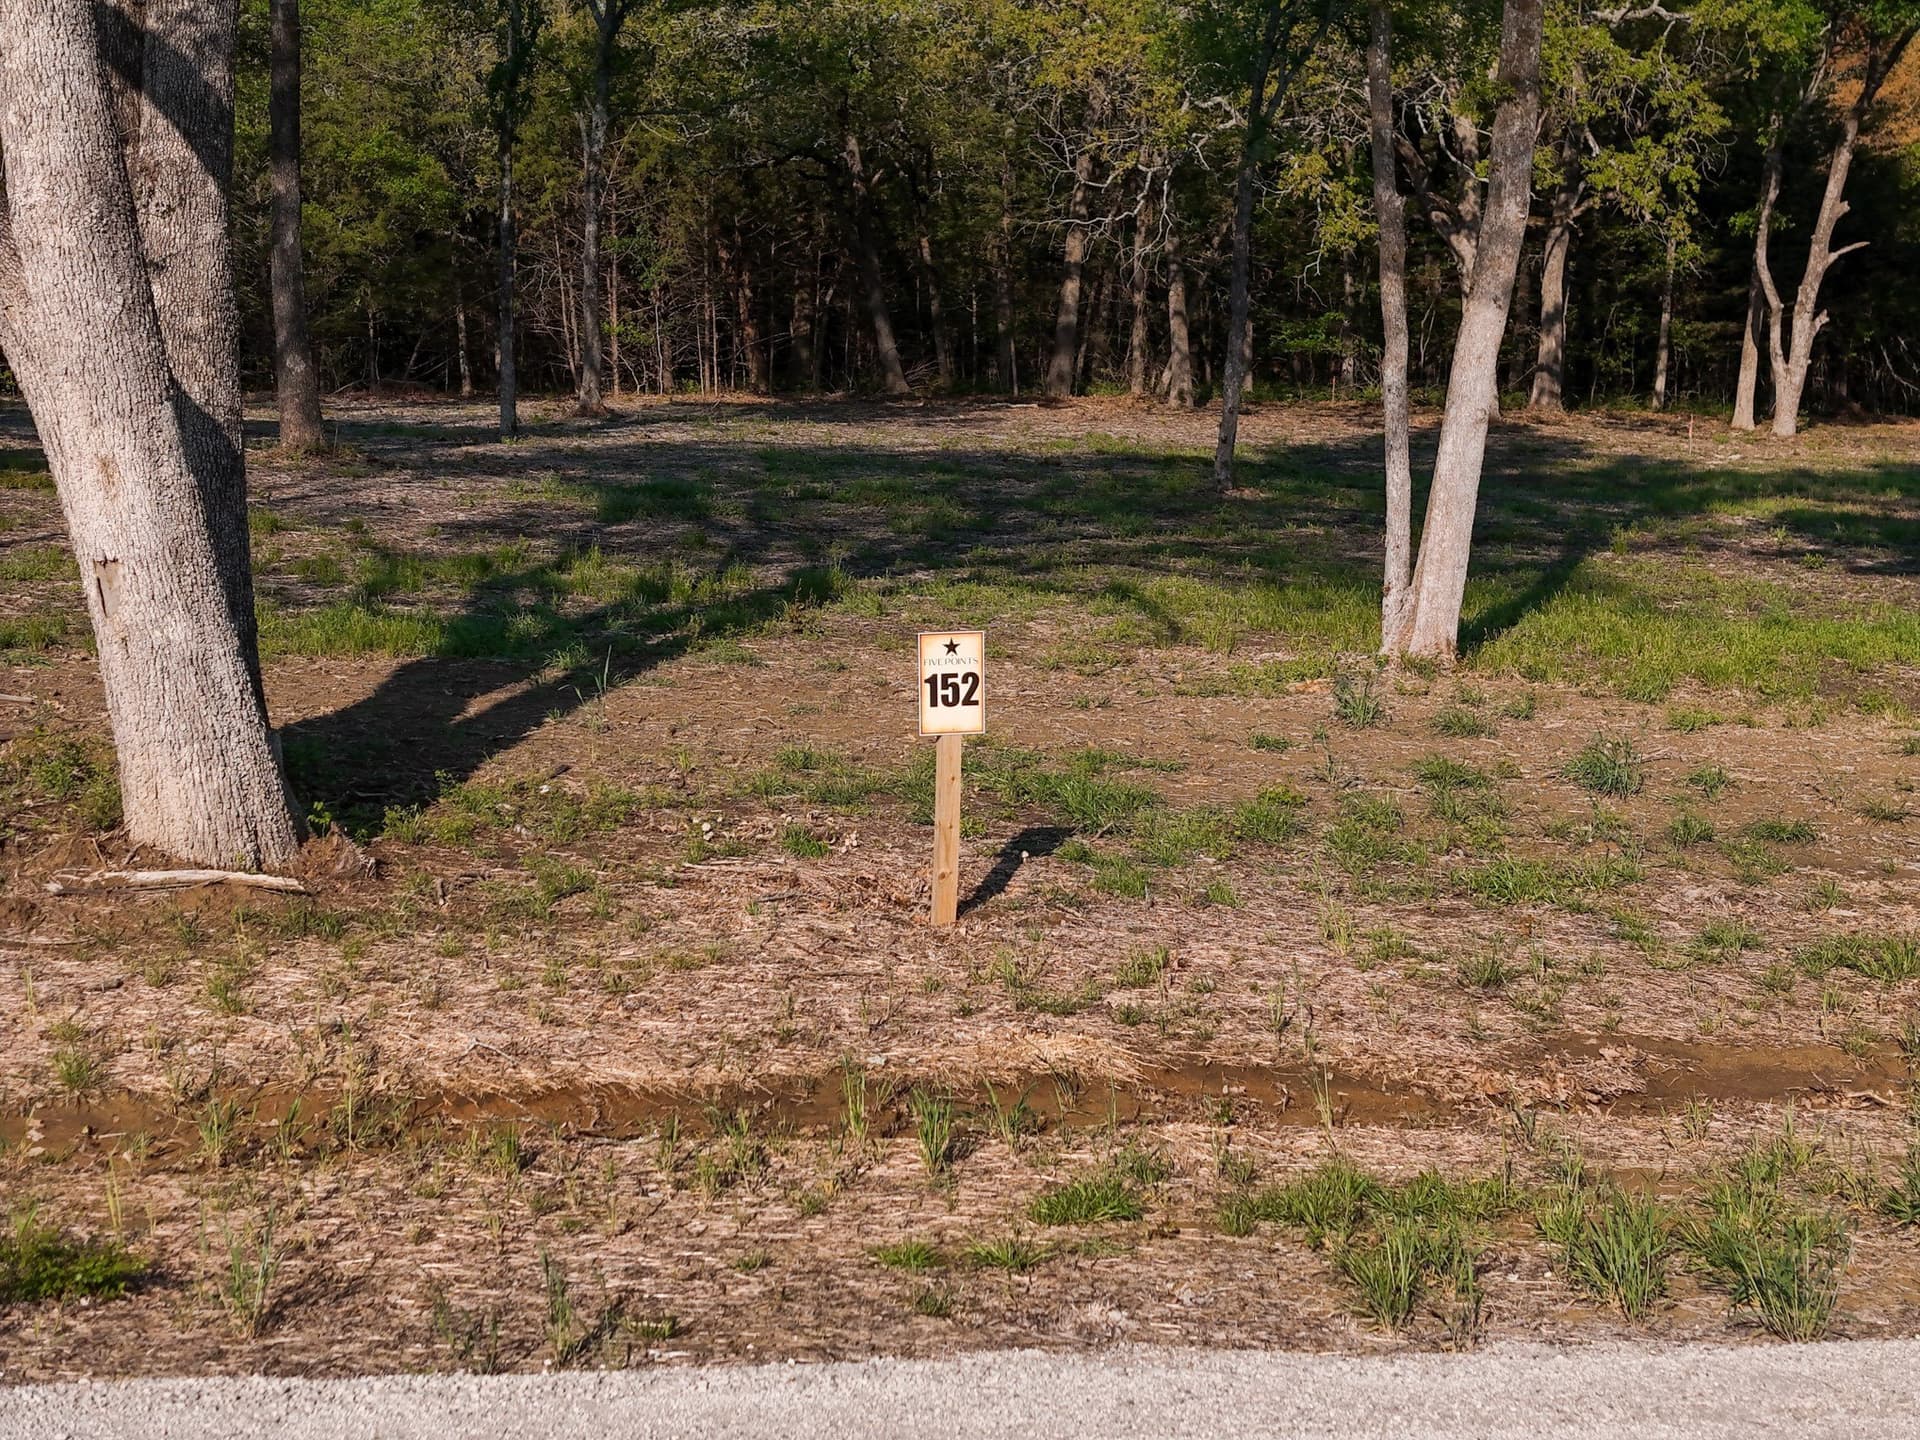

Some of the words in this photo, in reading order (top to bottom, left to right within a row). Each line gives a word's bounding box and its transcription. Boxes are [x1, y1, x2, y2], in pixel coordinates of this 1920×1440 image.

[923, 657, 942, 666] FIVE
[944, 656, 979, 666] POINTS
[924, 672, 980, 708] 152
